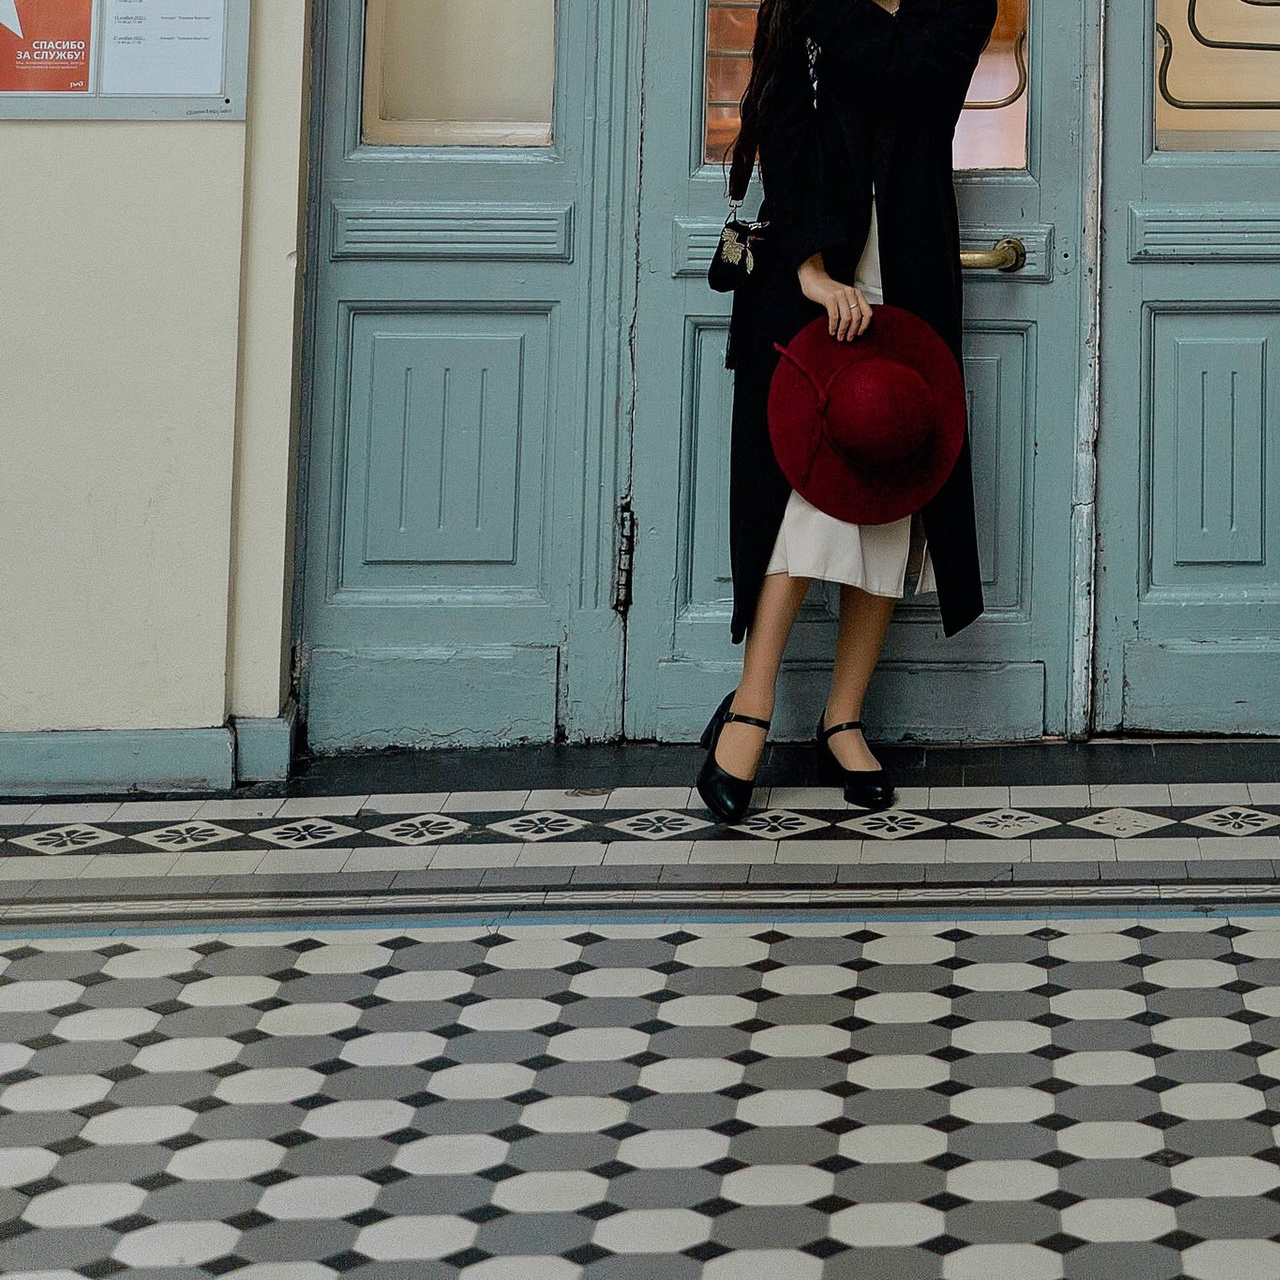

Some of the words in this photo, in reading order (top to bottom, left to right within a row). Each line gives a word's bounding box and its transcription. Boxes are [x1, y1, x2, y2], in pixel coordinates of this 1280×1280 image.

[32, 40, 85, 50] СПАСИБО
[16, 51, 31, 60] ЗА
[34, 51, 84, 60] СЛУЖБУ!
